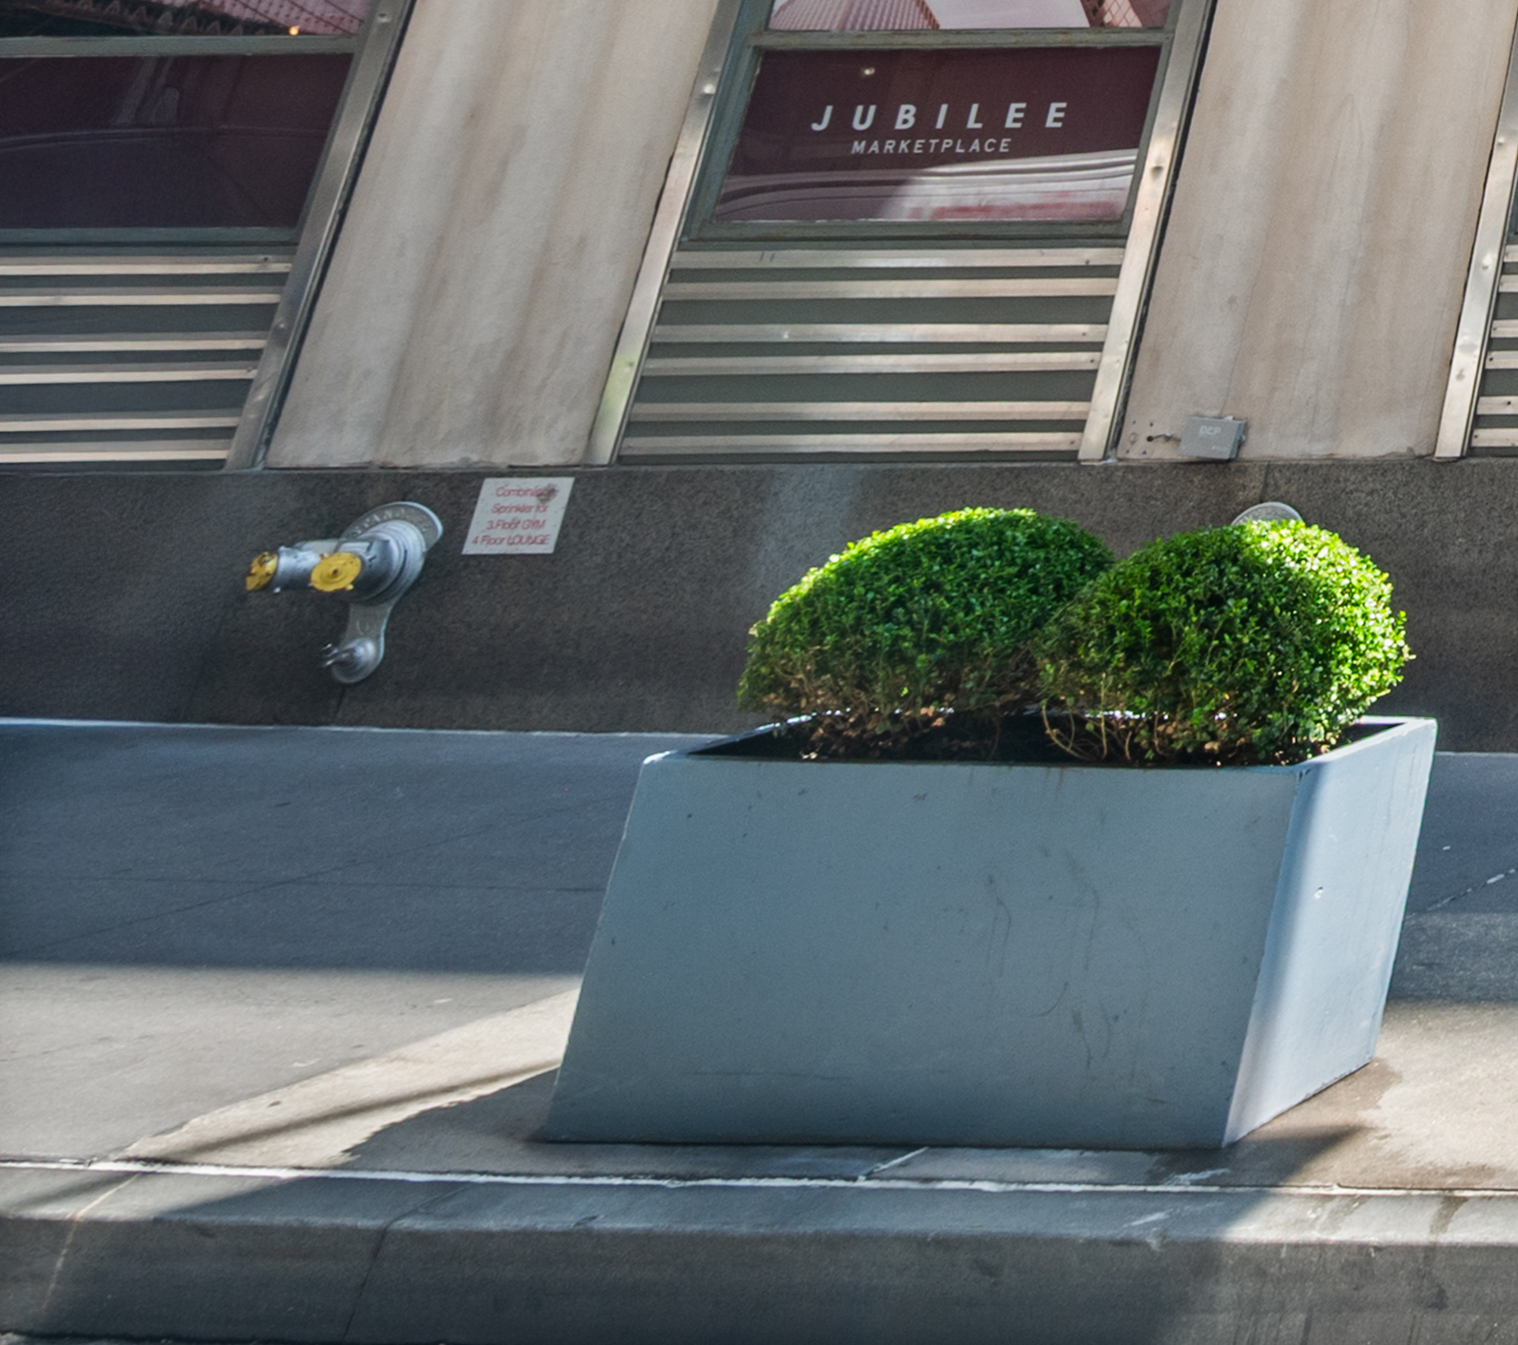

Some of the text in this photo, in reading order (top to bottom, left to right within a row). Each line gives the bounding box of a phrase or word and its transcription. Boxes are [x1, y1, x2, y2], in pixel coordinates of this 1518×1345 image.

[811, 103, 1067, 131] JUBILEE
[851, 138, 1011, 154] MARKETPLACE
[481, 535, 505, 545] Floor
[507, 534, 551, 546] LOUNGE
